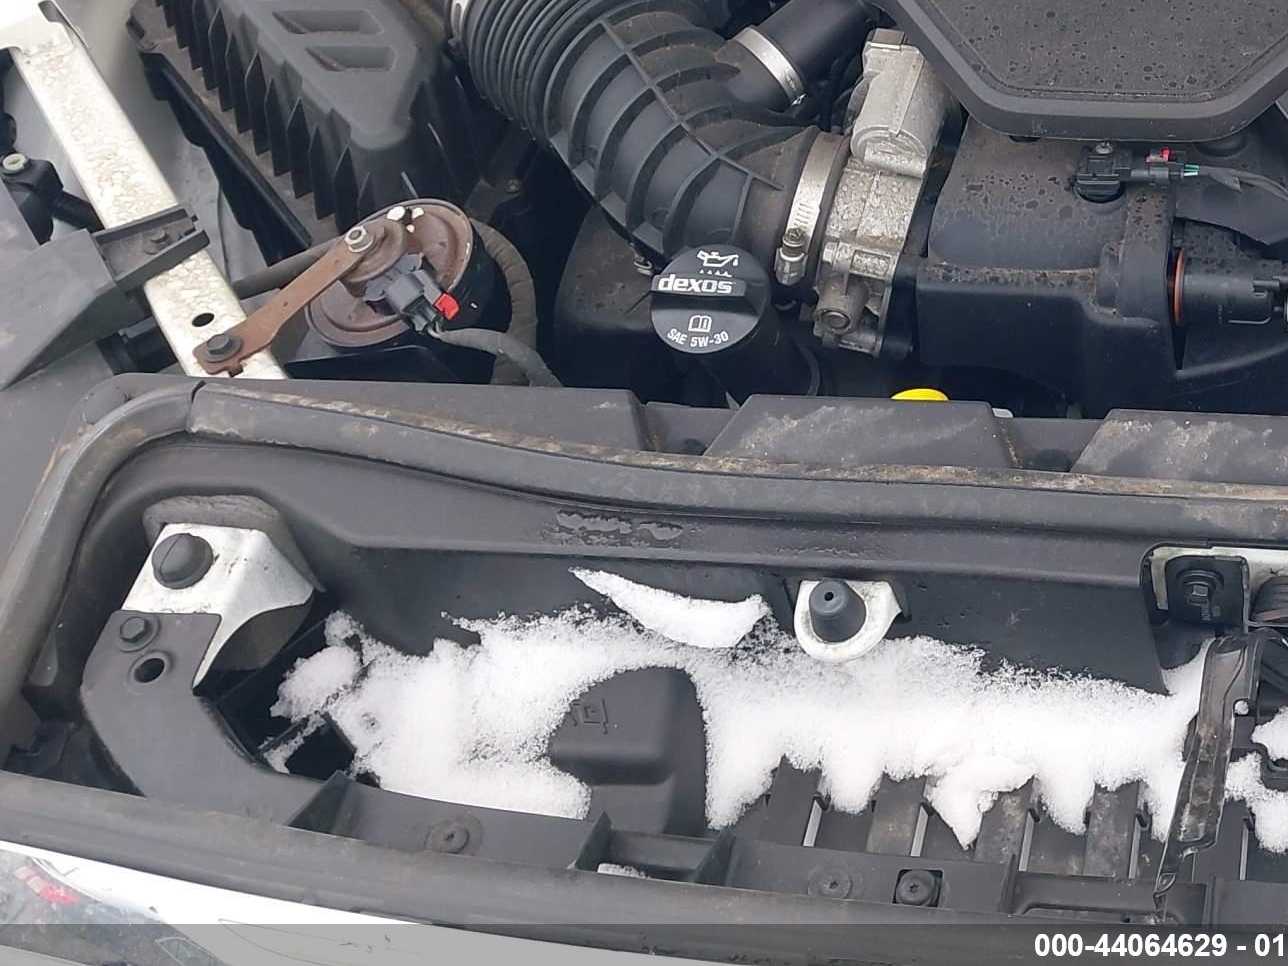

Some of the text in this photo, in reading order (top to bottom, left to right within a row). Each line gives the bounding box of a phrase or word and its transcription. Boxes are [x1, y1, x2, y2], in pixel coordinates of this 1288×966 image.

[658, 274, 733, 294] dexos
[667, 328, 729, 347] SAE 5W-30
